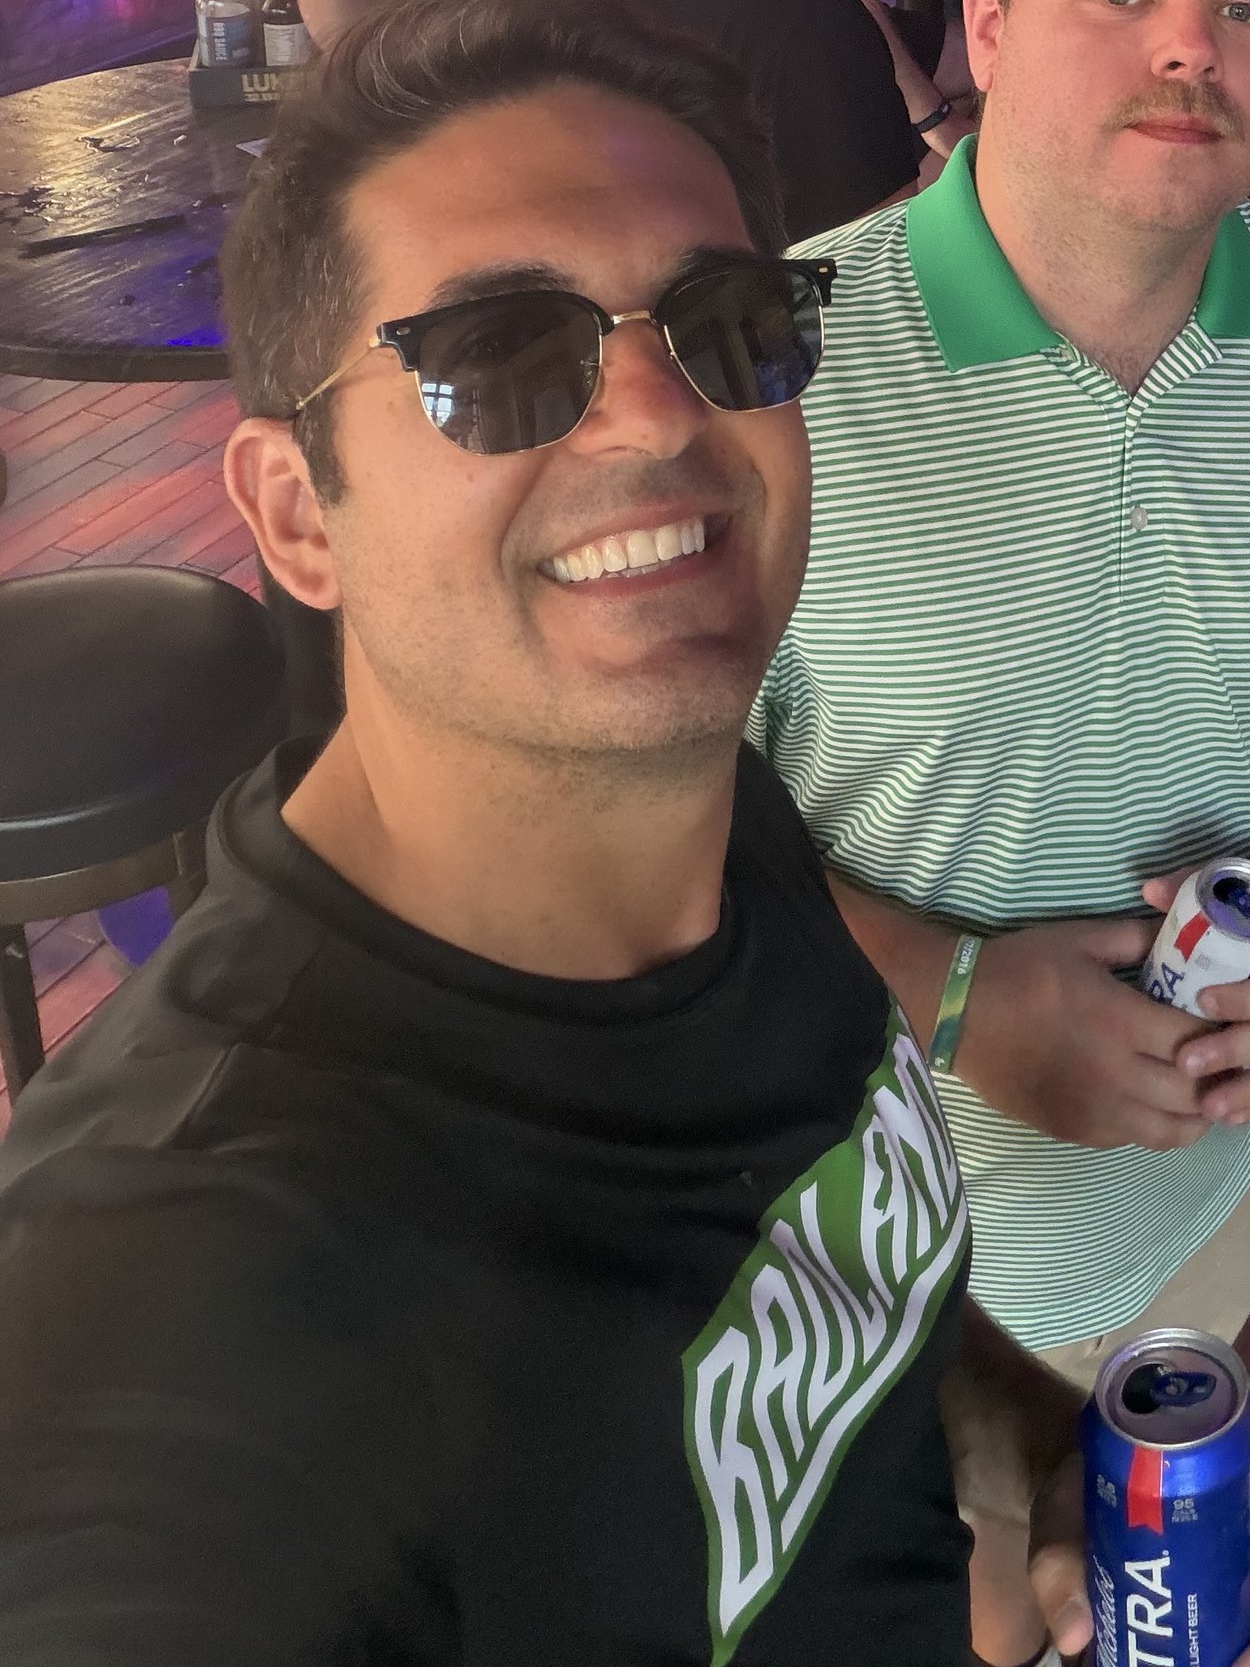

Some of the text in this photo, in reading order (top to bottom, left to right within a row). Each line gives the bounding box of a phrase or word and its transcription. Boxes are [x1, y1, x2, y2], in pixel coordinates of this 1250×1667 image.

[695, 1006, 958, 1638] BADLAND
[1124, 1556, 1175, 1667] TRA
[1187, 1593, 1199, 1627] BEER
